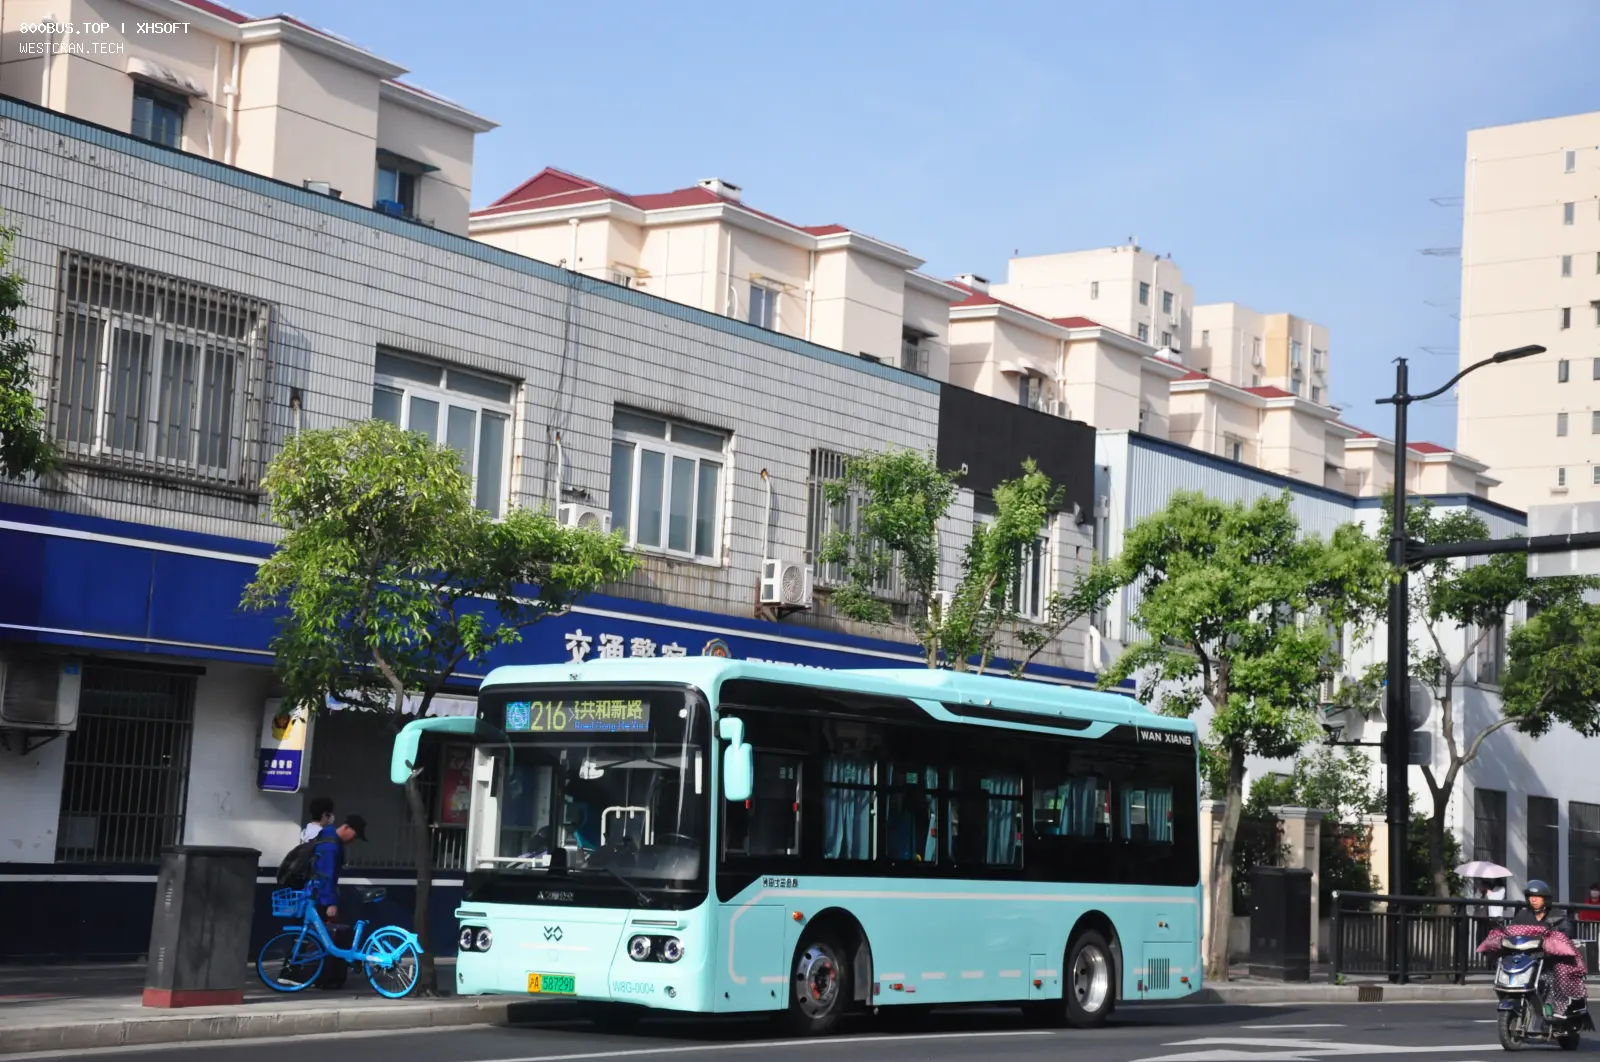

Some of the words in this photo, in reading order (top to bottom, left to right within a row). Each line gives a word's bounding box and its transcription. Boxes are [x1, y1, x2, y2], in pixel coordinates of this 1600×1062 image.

[530, 701, 567, 731] 216
[574, 700, 643, 720] 共和新路
[1140, 730, 1162, 742] WAN
[1164, 733, 1192, 746] XIANG
[612, 980, 655, 994] W8G-0004
